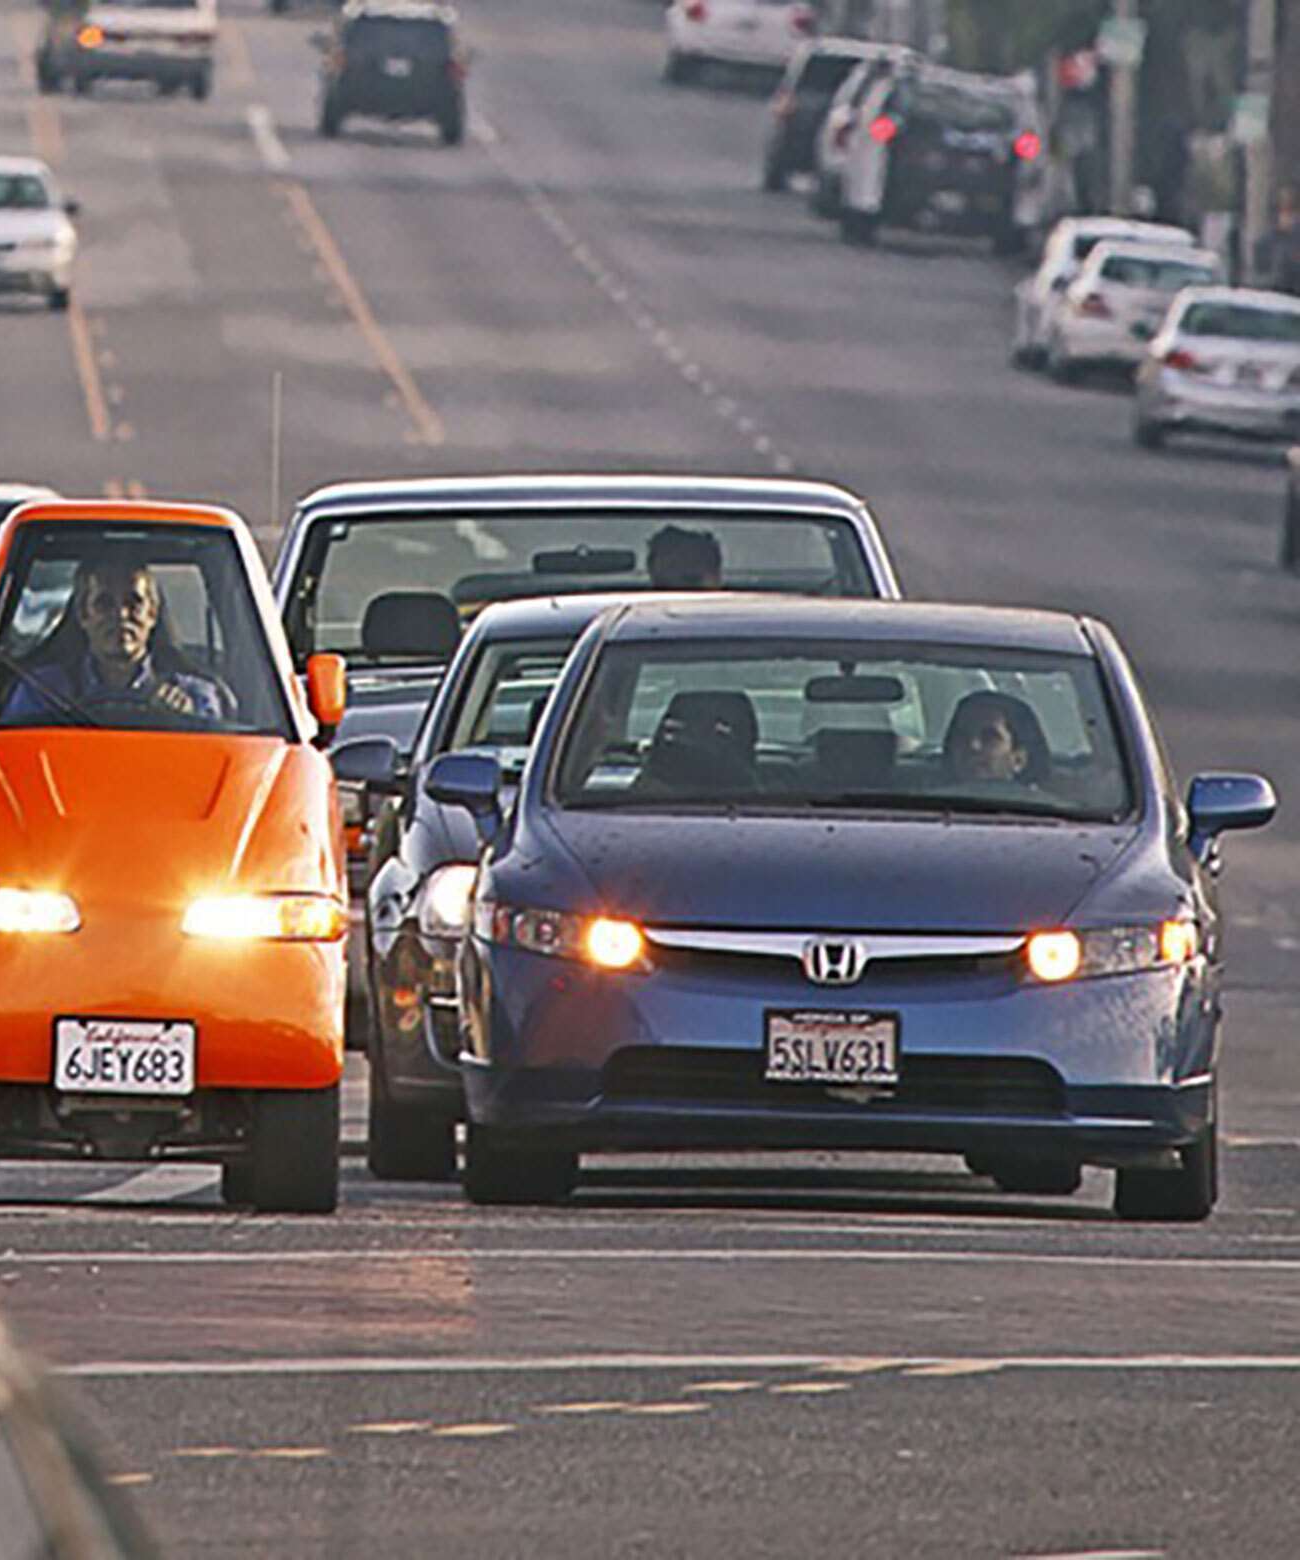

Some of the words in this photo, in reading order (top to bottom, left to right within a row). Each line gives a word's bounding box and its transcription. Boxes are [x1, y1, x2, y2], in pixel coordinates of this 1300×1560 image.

[86, 1026, 164, 1046] California
[65, 1047, 185, 1083] 6JEY683
[774, 1037, 888, 1073] 5SLV631
